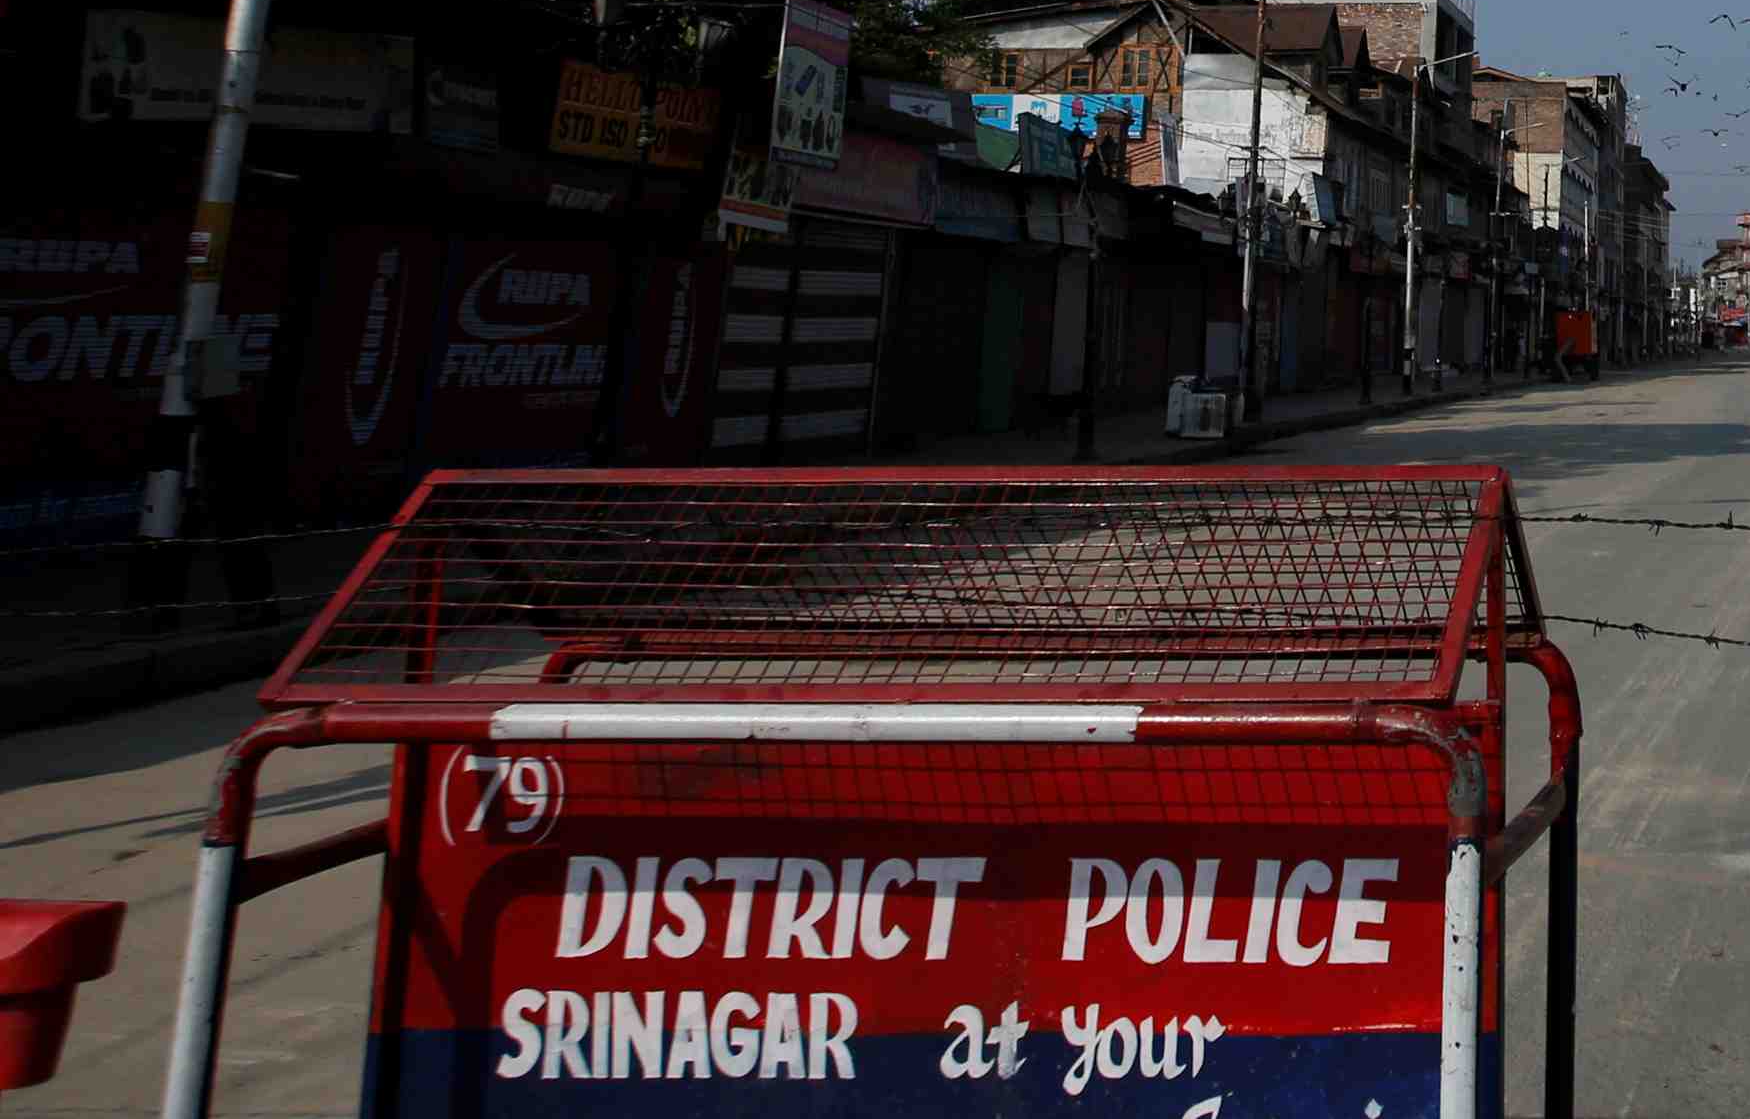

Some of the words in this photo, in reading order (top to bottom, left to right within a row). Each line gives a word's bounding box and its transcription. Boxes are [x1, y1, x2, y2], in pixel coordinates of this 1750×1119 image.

[439, 745, 565, 846] (79)
[555, 855, 988, 960] DISTRICT
[1061, 857, 1400, 967] POLICE
[495, 988, 859, 1080] SRINAGAR
[939, 1000, 1030, 1081] at
[1060, 1002, 1227, 1097] your
